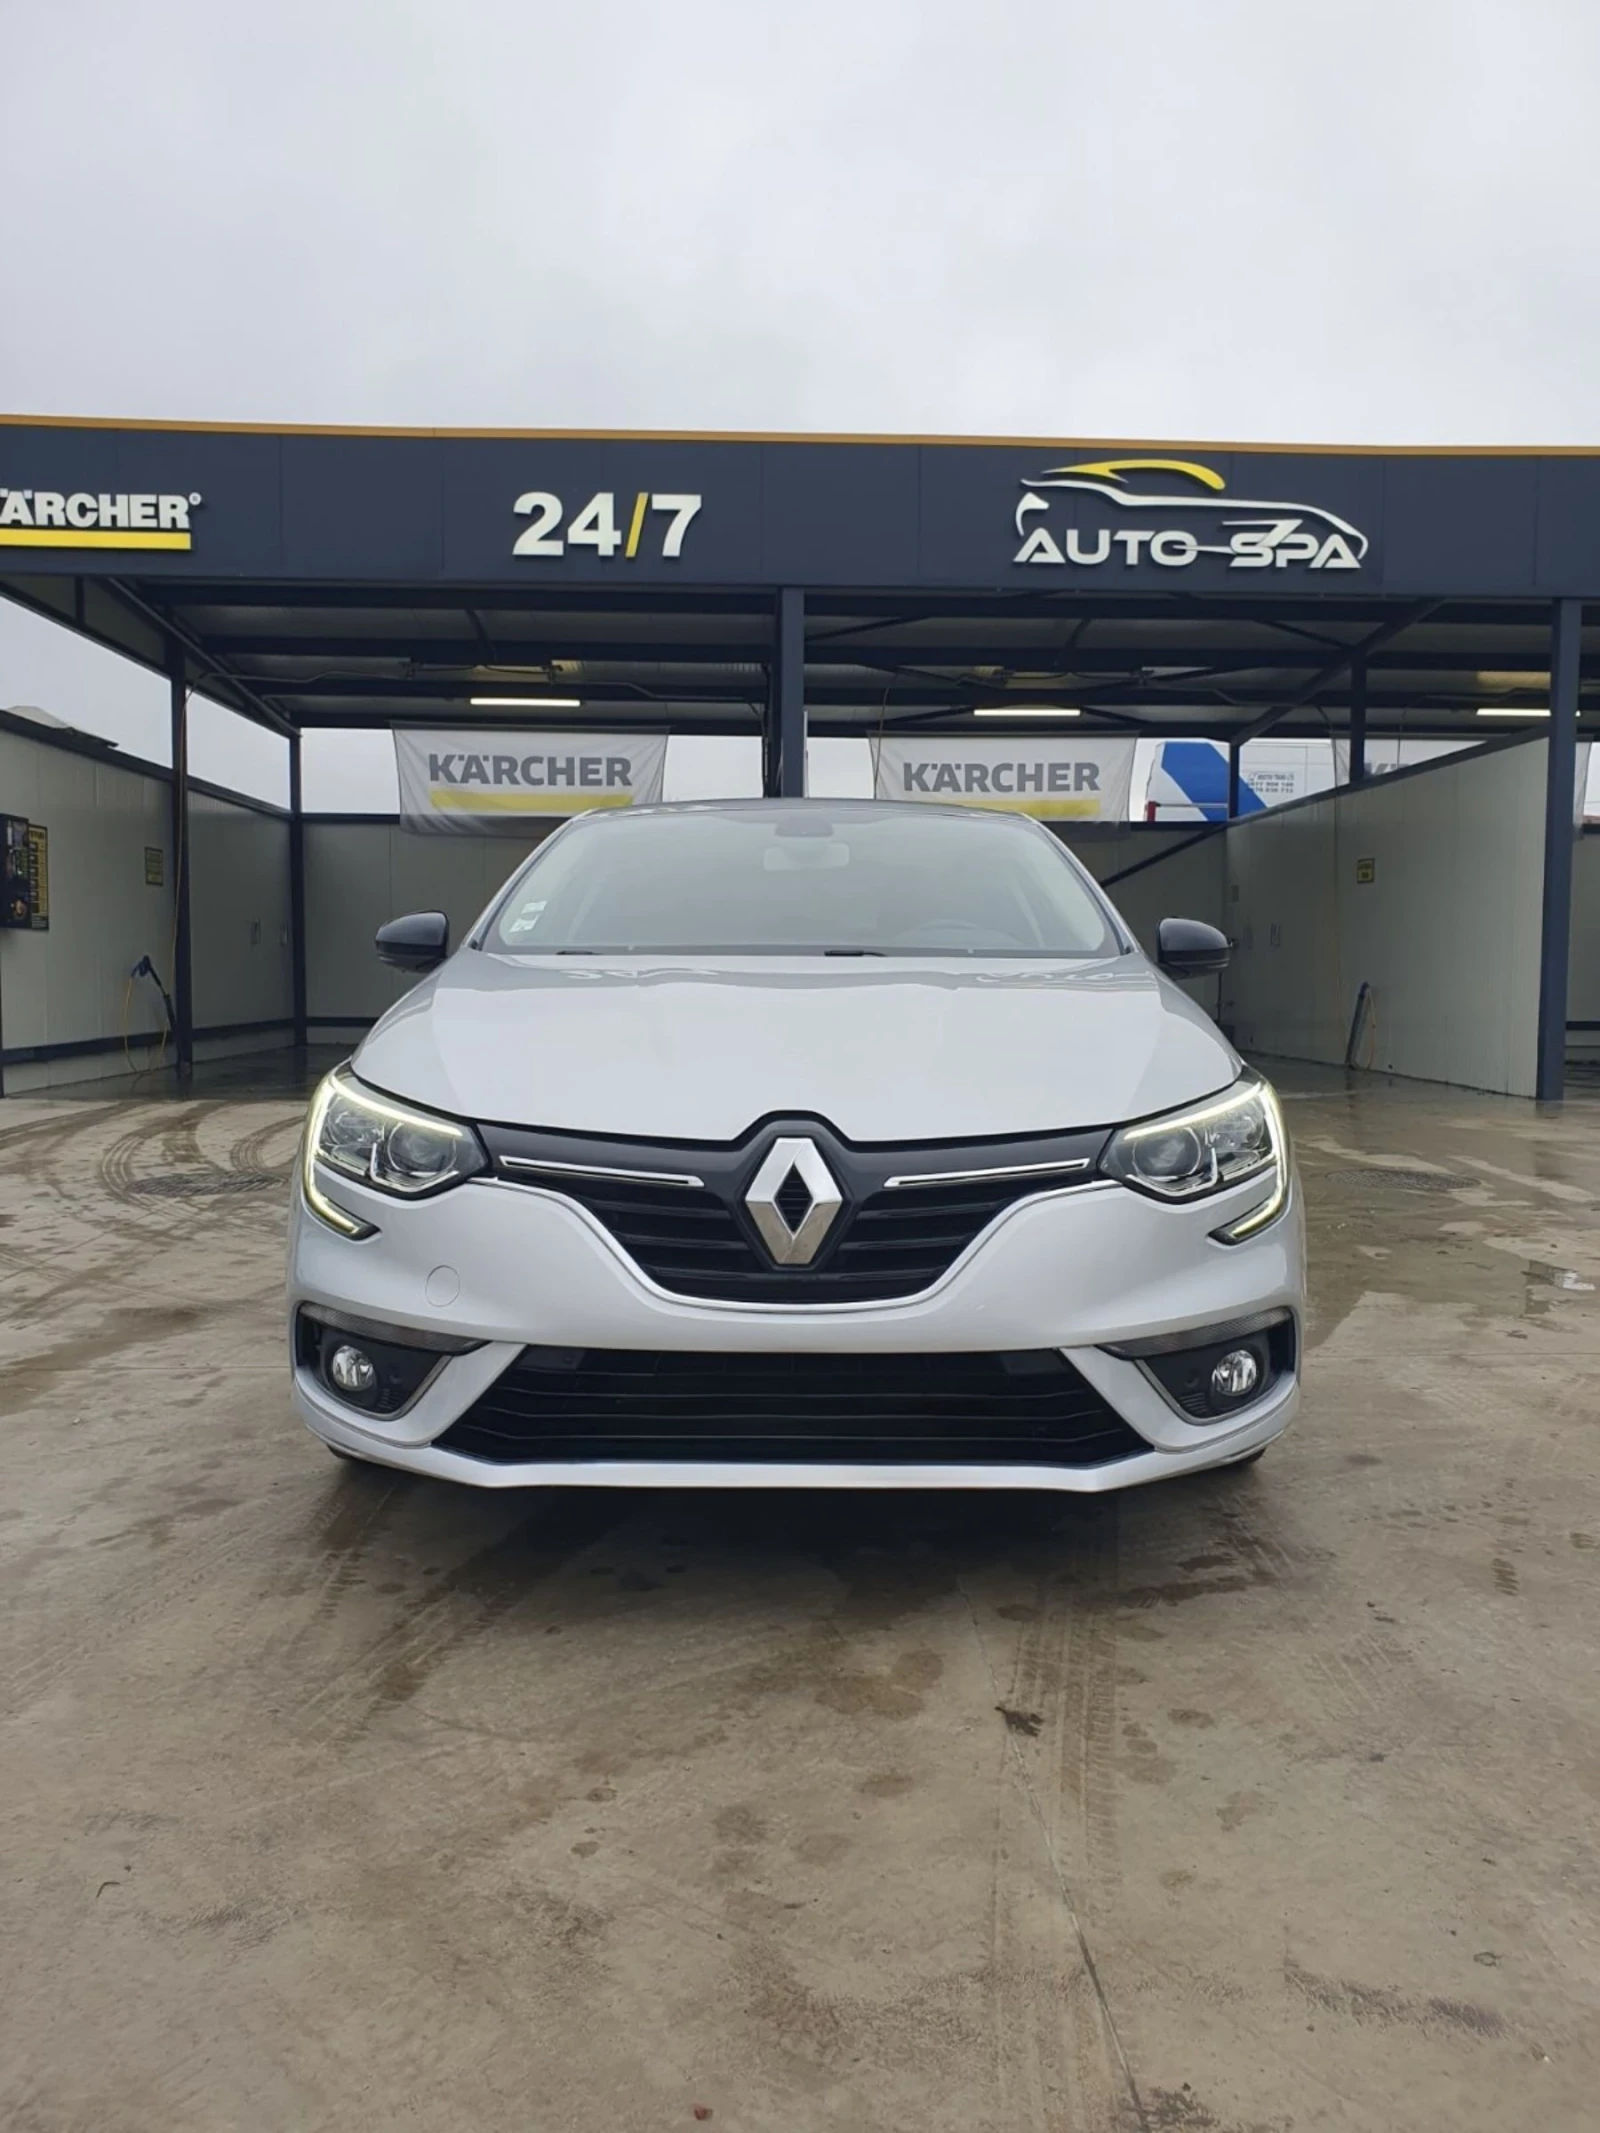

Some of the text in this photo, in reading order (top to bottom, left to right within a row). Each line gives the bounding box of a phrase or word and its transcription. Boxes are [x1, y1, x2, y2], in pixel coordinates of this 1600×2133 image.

[512, 491, 702, 557] 24/7
[1013, 528, 1199, 566] AUTO
[429, 753, 633, 786] KÄRCHER
[903, 762, 1101, 792] KÄRCHER
